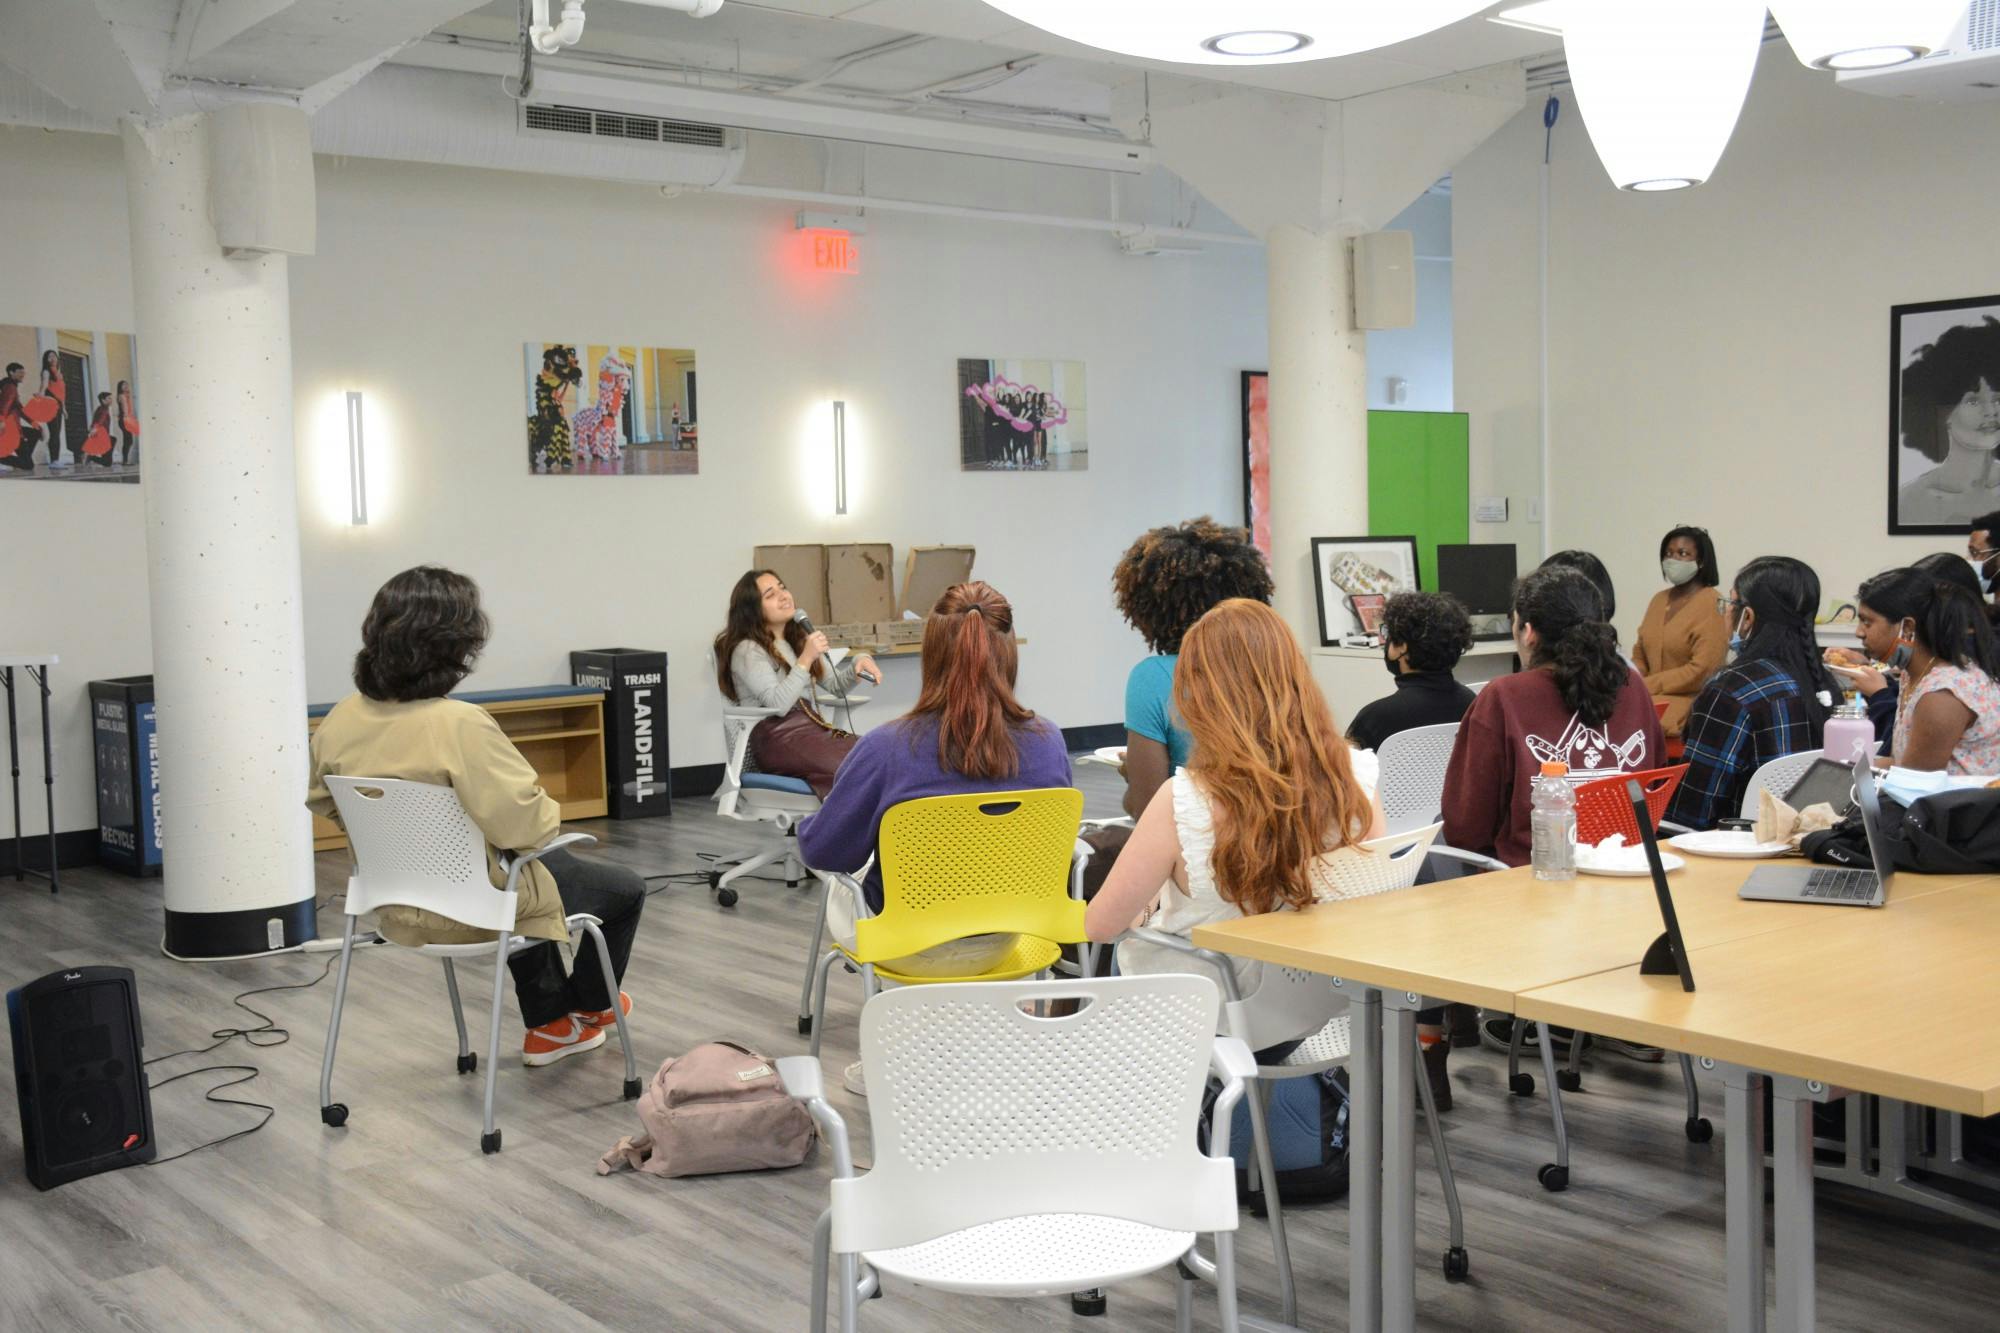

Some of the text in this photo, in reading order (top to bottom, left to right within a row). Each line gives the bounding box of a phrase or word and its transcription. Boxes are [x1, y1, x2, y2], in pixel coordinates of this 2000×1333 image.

[815, 236, 848, 271] EXIT
[576, 674, 612, 691] LANDFILL
[624, 673, 661, 686] TRASH
[98, 703, 123, 719] PLASTIC
[634, 690, 654, 803] LANDFILL
[101, 825, 135, 850] RECYCLE
